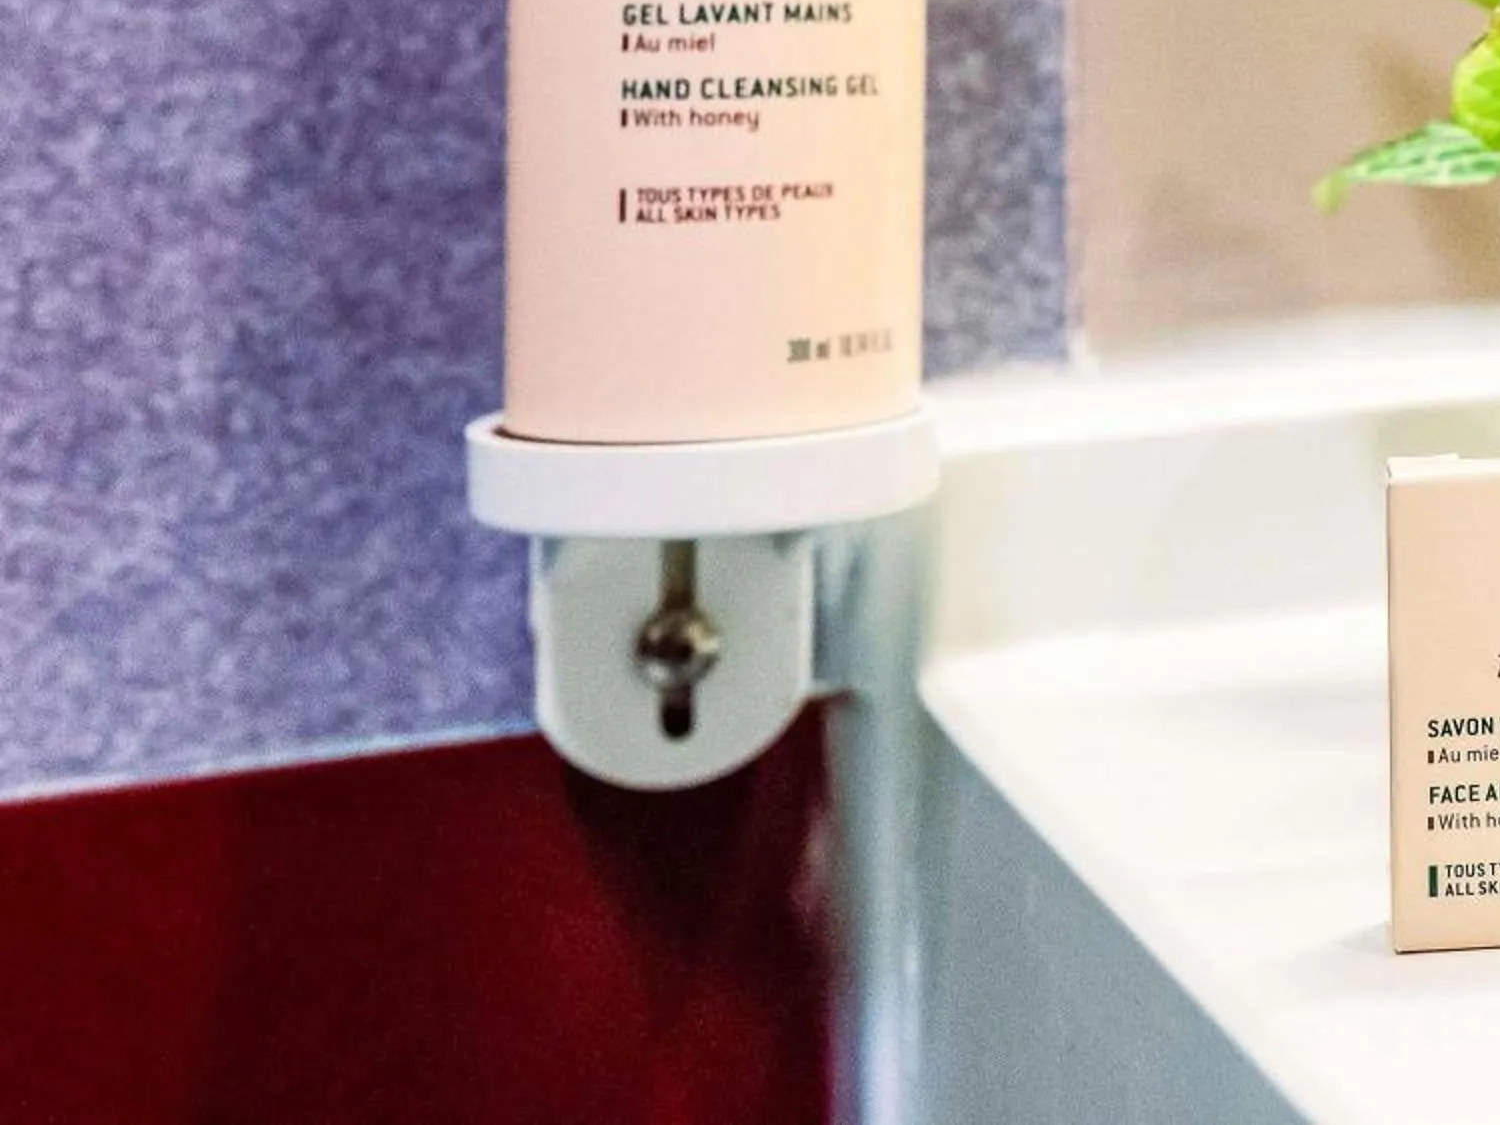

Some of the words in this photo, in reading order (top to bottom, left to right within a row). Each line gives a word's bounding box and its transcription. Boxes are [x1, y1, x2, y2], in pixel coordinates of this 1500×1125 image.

[622, 4, 667, 26] GEL
[679, 3, 774, 25] LAVANT
[784, 2, 853, 23] MAINS
[634, 35, 660, 52] Au
[668, 33, 716, 52] miel
[621, 78, 691, 100] HAND
[700, 75, 838, 100] CLEANSING
[846, 74, 879, 97] GEL
[633, 108, 681, 128] With
[689, 108, 760, 132] honey
[636, 187, 682, 205] TOUS
[688, 185, 745, 203] TYPES
[752, 184, 774, 201] DE
[636, 207, 666, 223] ALL
[674, 206, 718, 223] SKIN
[724, 204, 781, 221] TYPES
[1427, 715, 1495, 738] SAVON
[1438, 748, 1461, 764] Au
[1429, 784, 1480, 804] FACE
[1438, 813, 1480, 831] With
[1445, 862, 1486, 879] TOUS
[1444, 881, 1475, 898] ALL
